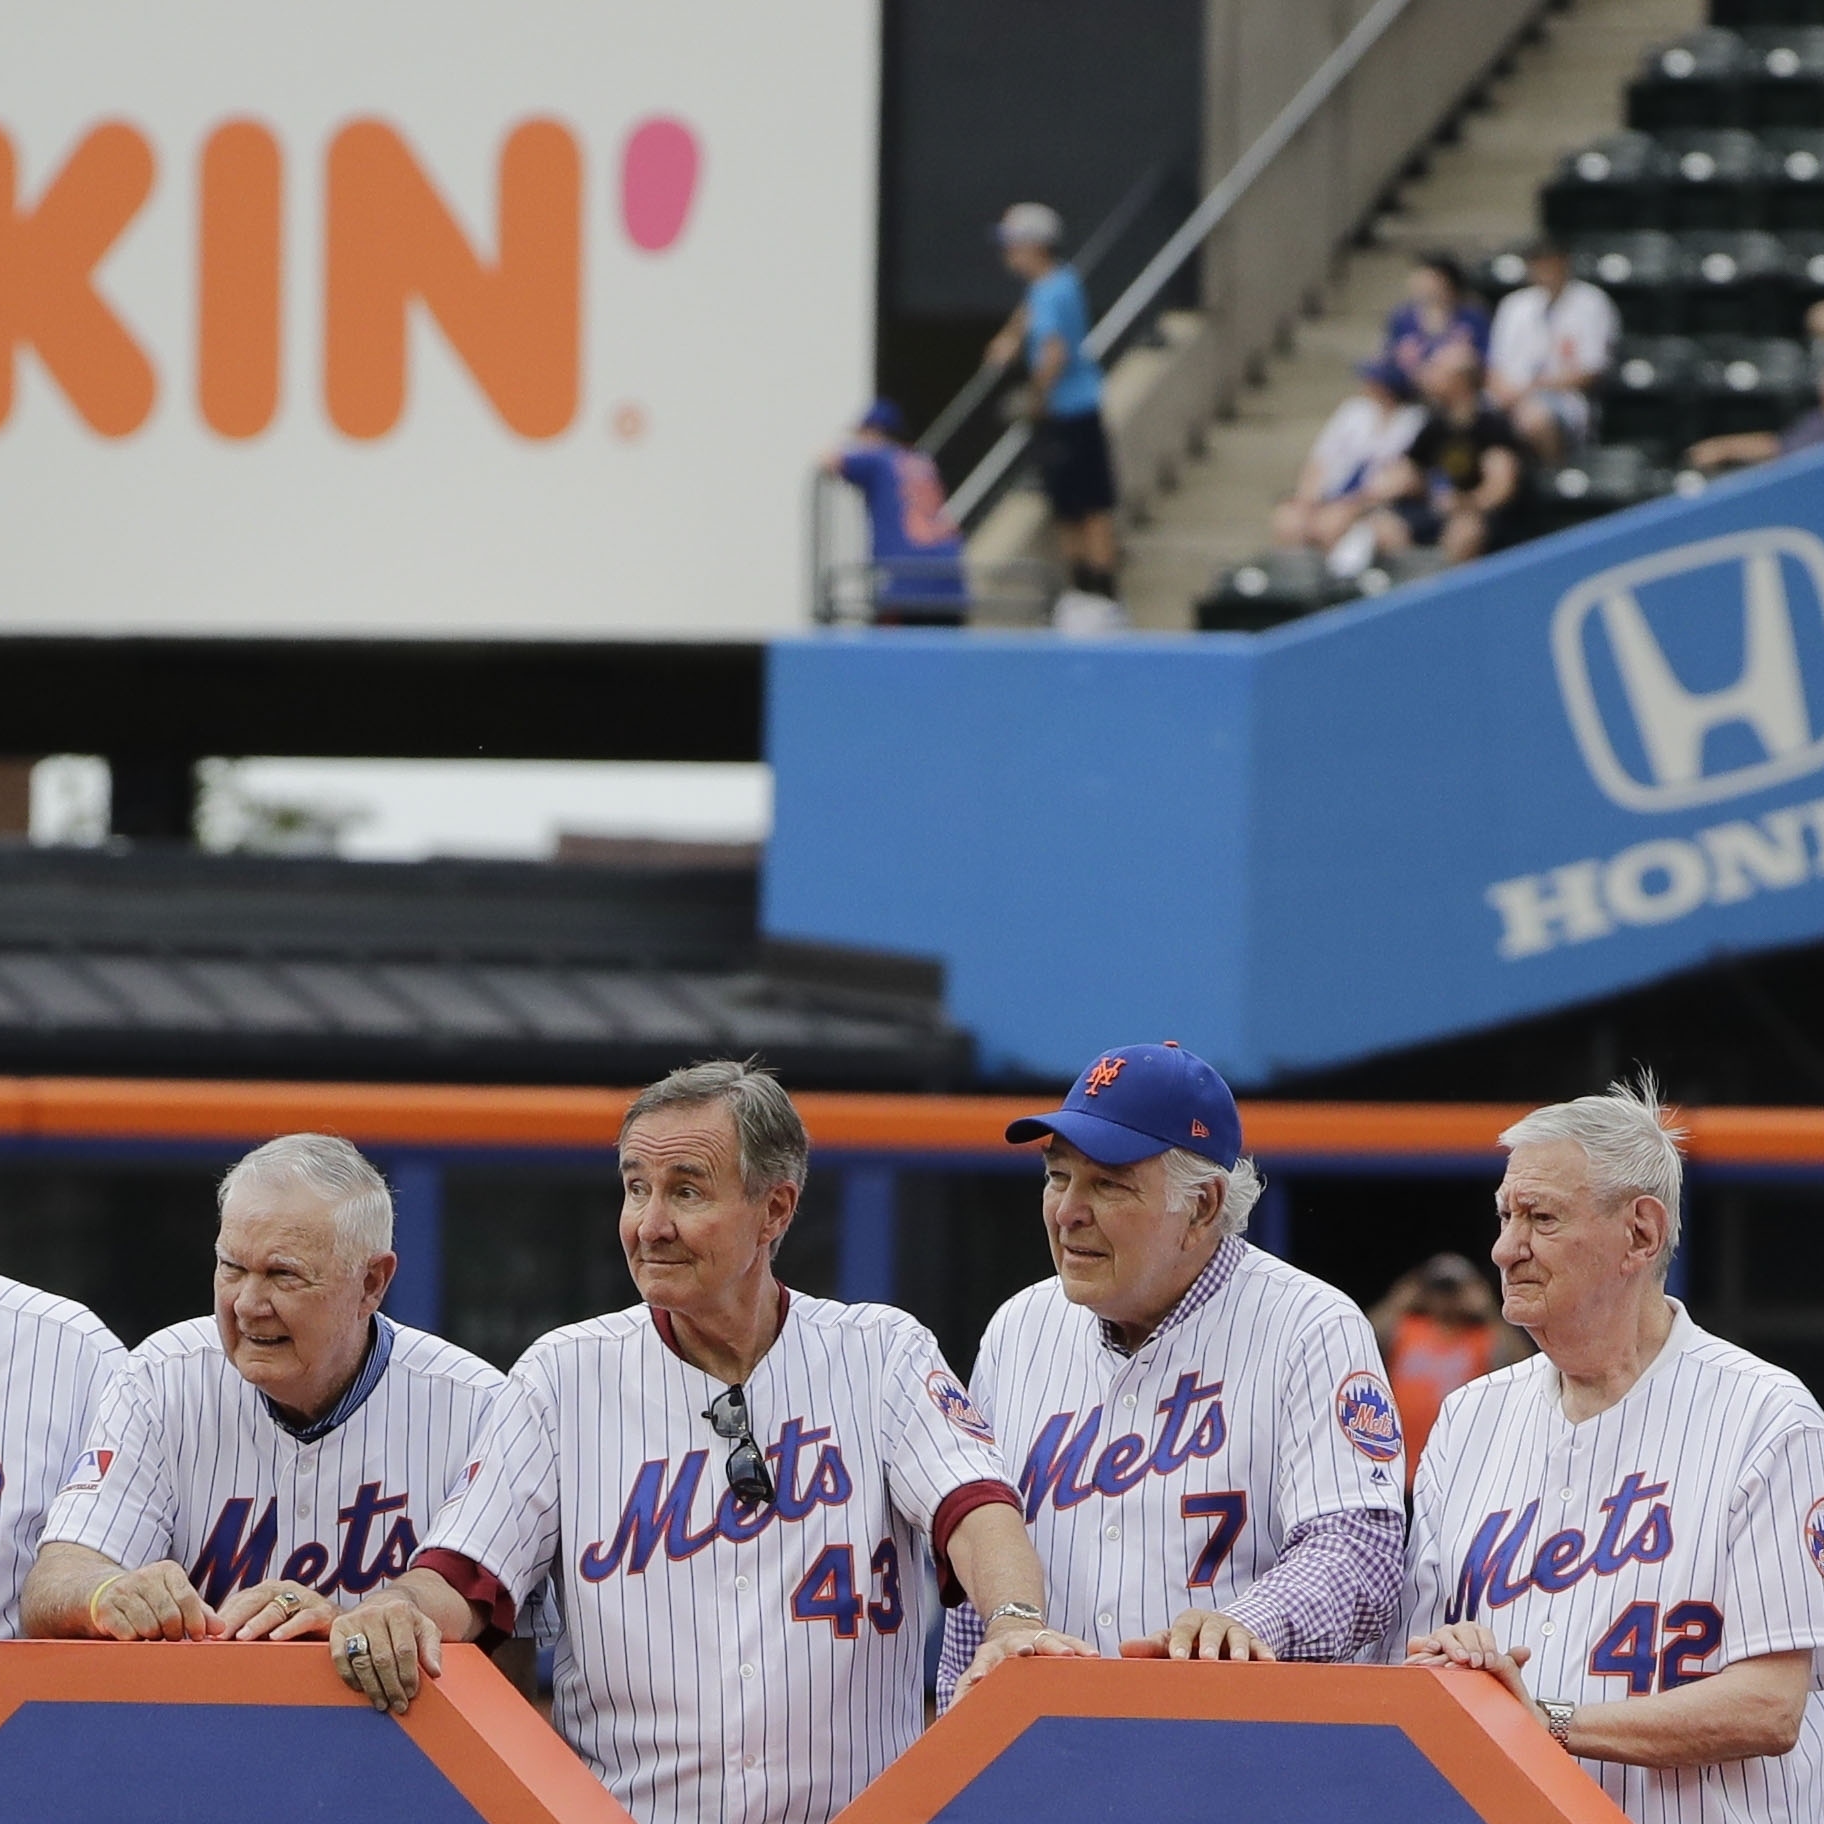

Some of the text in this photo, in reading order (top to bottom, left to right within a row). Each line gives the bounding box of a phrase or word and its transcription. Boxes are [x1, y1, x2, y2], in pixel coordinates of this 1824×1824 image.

[580, 1416, 855, 1584] Mets
[1019, 1371, 1226, 1525] Mets
[190, 1480, 420, 1613] Mets
[790, 1537, 904, 1640] 43
[1180, 1490, 1248, 1588] 7
[1444, 1472, 1674, 1626] Mets
[1588, 1599, 1724, 1698] 42
